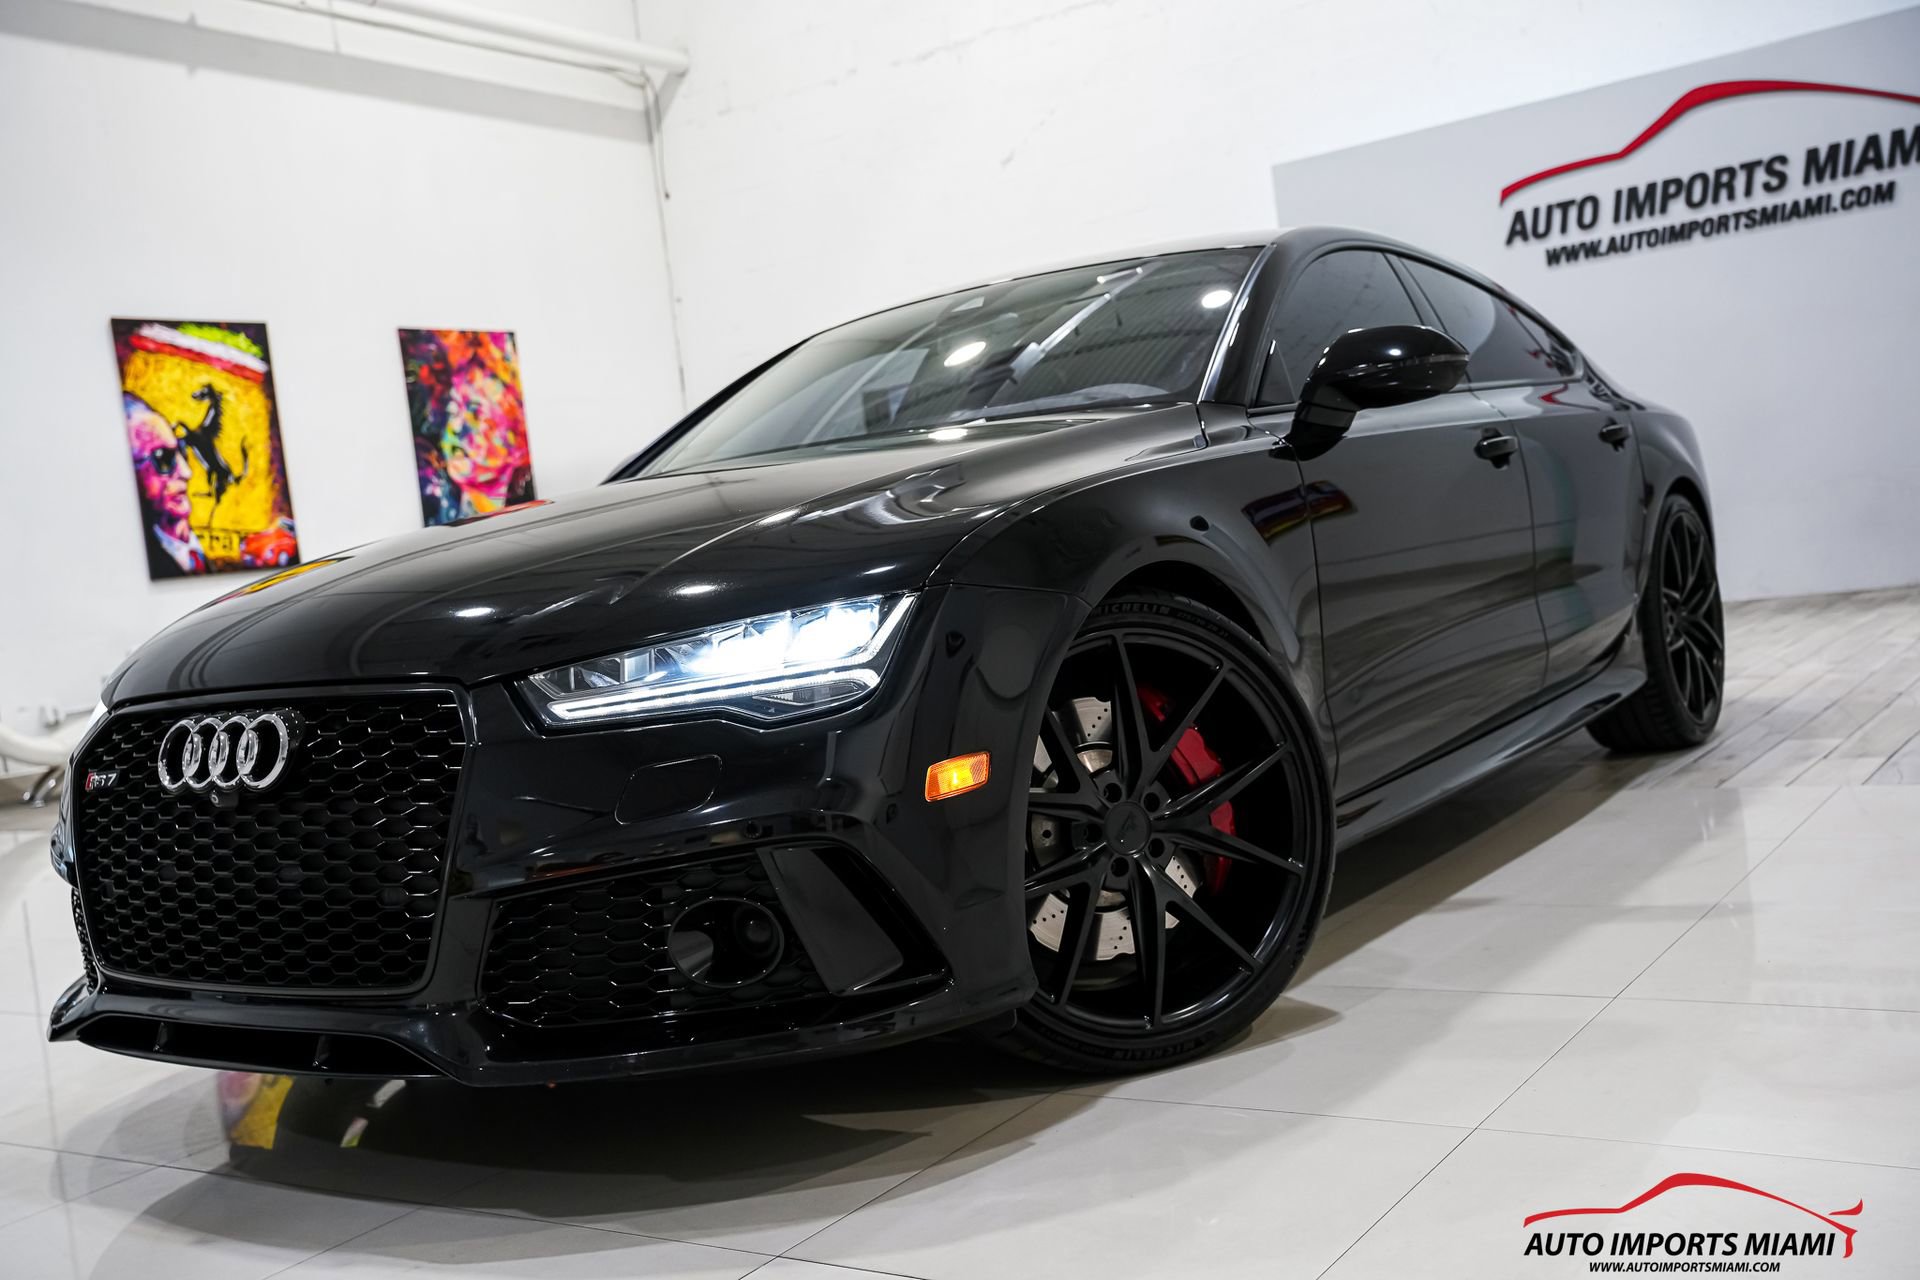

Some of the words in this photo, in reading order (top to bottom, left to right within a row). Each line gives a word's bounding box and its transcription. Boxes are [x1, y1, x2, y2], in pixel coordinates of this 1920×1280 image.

[1506, 195, 1600, 246] AUTO
[1613, 154, 1789, 224] IMPORTS
[1546, 180, 1896, 267] WWW.AUTOIMPORTSMIAMI.COM
[1090, 602, 1171, 617] MICHELIN
